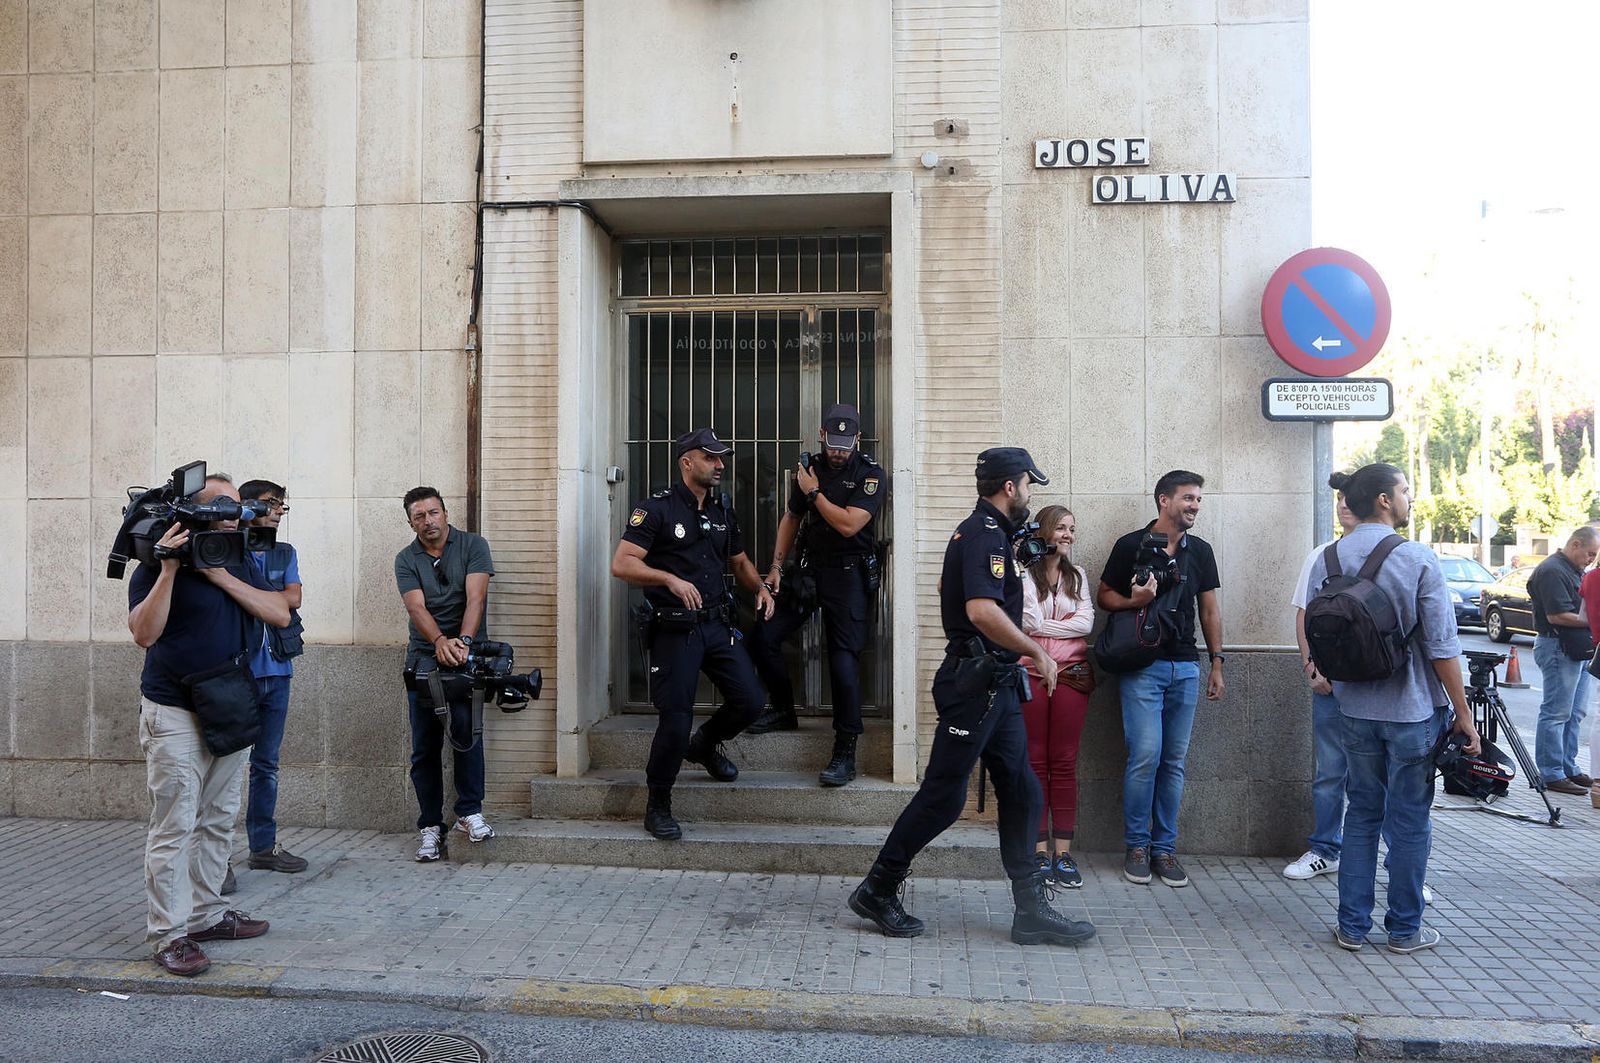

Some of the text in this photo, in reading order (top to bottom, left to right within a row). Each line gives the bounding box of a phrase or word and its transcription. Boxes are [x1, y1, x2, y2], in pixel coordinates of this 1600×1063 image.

[1039, 138, 1145, 167] JOSE
[1096, 174, 1234, 201] OLIVA
[1276, 384, 1289, 393] DE
[1311, 384, 1318, 393] A
[1344, 384, 1378, 393] HORAS
[1277, 393, 1376, 402] EXCEPTO VEHICULOS
[1296, 402, 1351, 411] POLICIALES
[949, 726, 970, 737] CNP
[1473, 764, 1498, 775] Canon
